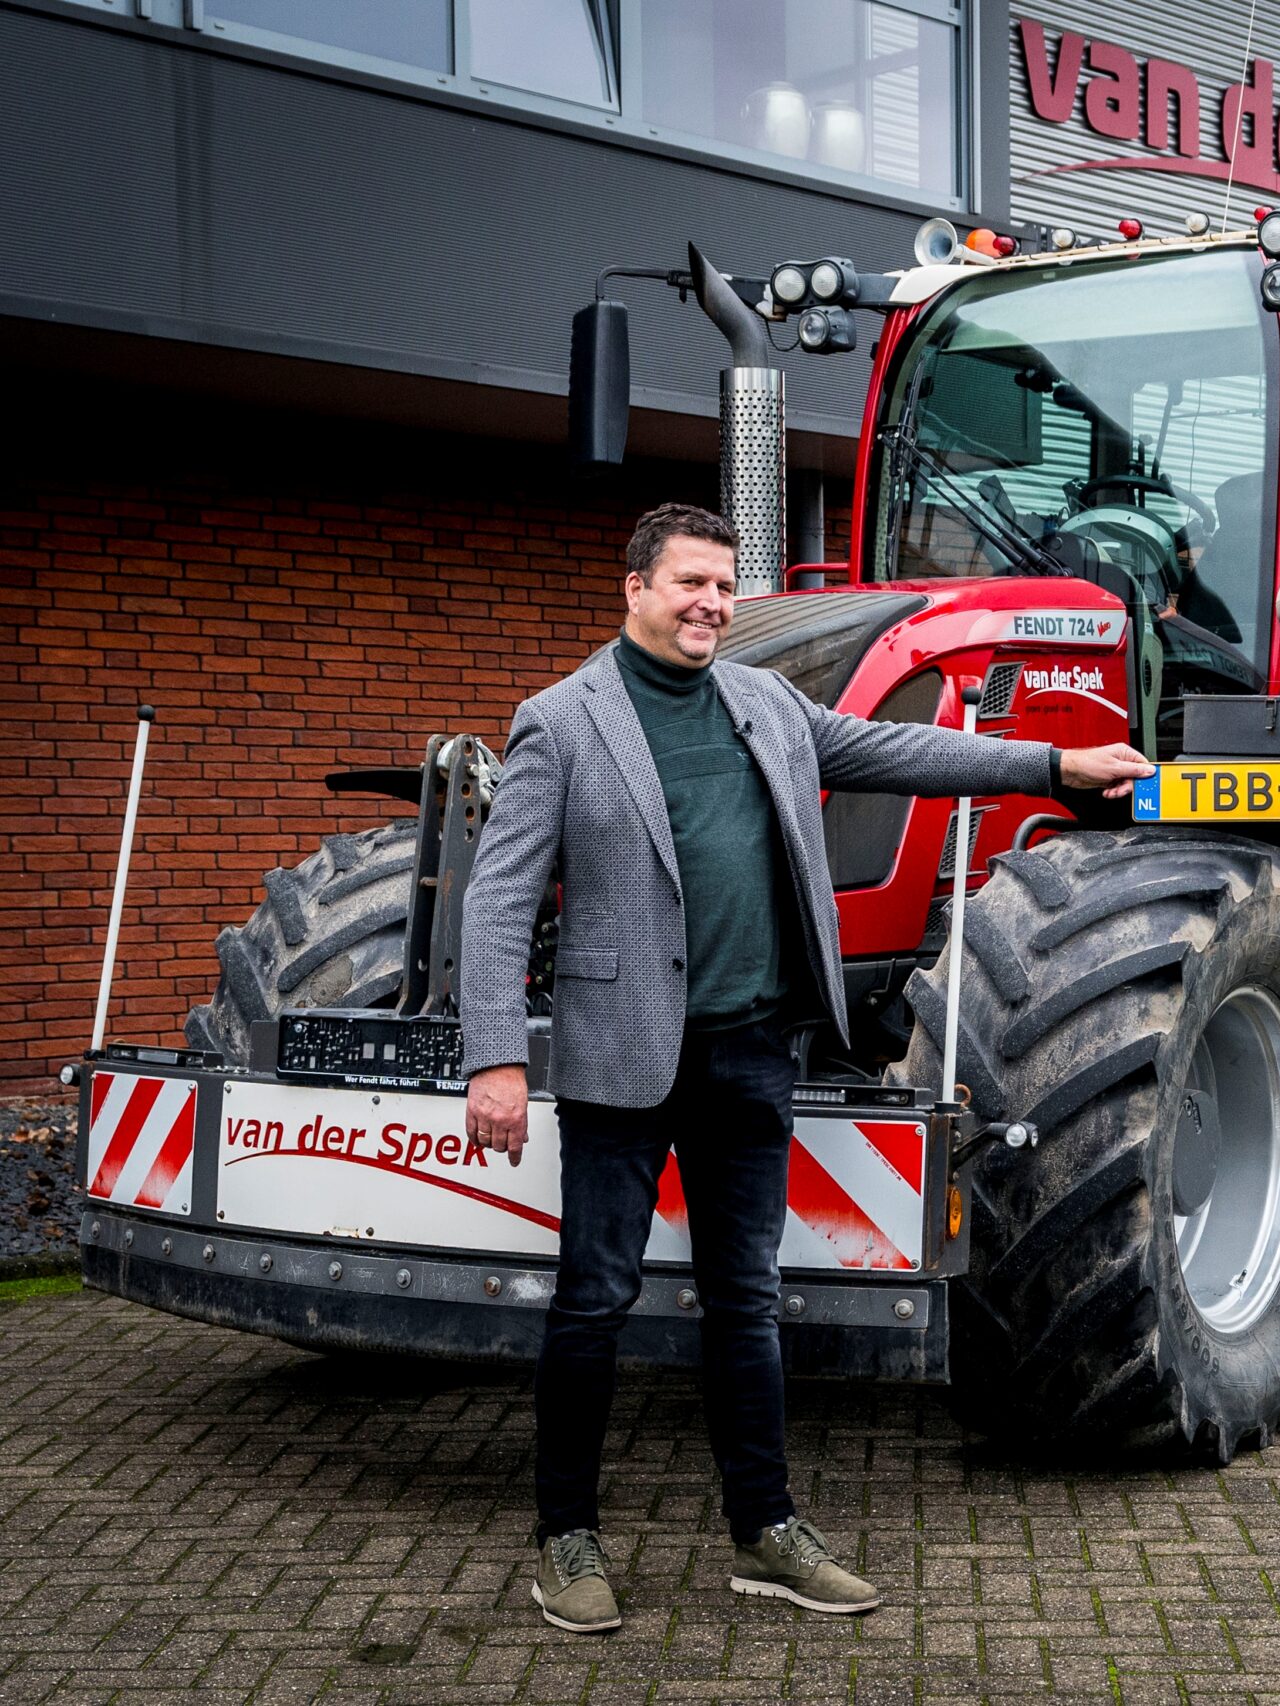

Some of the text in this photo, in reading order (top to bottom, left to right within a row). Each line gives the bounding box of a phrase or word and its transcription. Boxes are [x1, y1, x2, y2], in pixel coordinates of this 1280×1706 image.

[1017, 18, 1200, 158] van
[1013, 615, 1064, 636] FENDT
[1068, 617, 1095, 637] 724
[1023, 664, 1105, 691] van der Spek
[1138, 798, 1157, 811] NL
[344, 1075, 358, 1083] Wer
[358, 1076, 378, 1085] Fendt
[436, 1080, 467, 1090] FENDT
[226, 1116, 285, 1151] van
[297, 1114, 367, 1153] der
